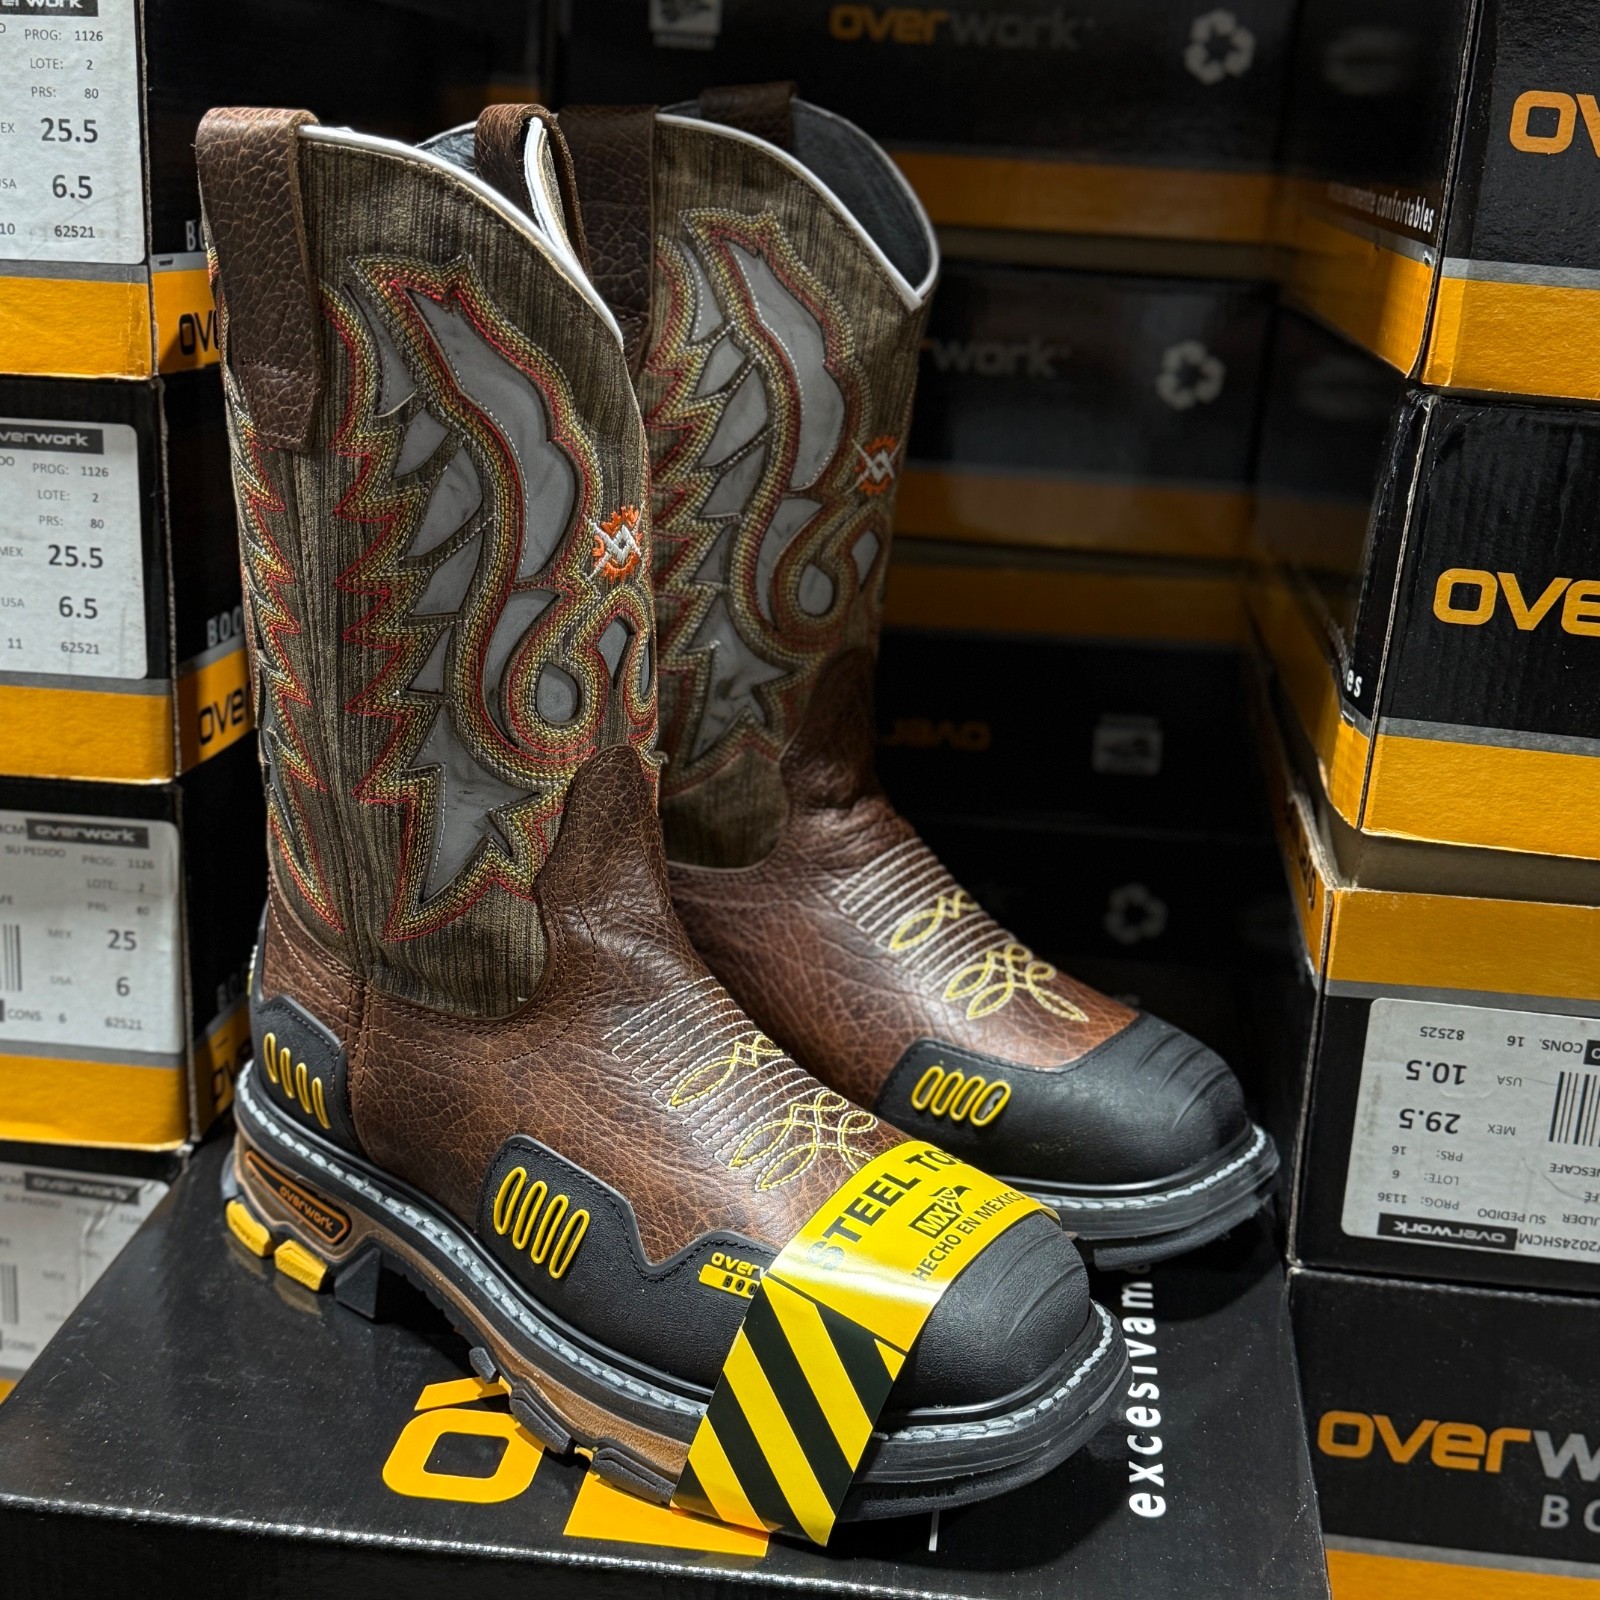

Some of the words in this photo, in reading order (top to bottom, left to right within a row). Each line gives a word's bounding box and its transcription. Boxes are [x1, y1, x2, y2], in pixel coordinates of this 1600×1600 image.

[24, 29, 62, 41] PROG:
[74, 30, 104, 42] 1126
[30, 58, 63, 70] LOTE:
[86, 60, 93, 71] 2
[31, 87, 56, 98] PRS:
[84, 88, 99, 100] 80
[40, 117, 99, 144] 25.5
[0, 178, 17, 190] SA
[52, 174, 93, 200] 6.5
[1376, 190, 1435, 233] confortables
[54, 224, 96, 239] 62521
[32, 462, 69, 476] PROG:
[80, 466, 110, 478] 1126
[37, 489, 70, 501] LOTE:
[91, 492, 100, 504] 2
[38, 514, 63, 527] PRS:
[90, 518, 105, 530] 80
[48, 544, 104, 569] 25.5
[1, 596, 25, 608] USA
[58, 595, 98, 620] 6.5
[7, 637, 24, 650] 11
[60, 641, 101, 655] 62521
[34, 824, 136, 842] overwork
[107, 929, 137, 951] 25
[116, 976, 130, 997] 6
[104, 1016, 143, 1031] 62521
[1419, 1026, 1466, 1041] 82525
[1506, 1035, 1526, 1048] 16
[1539, 1038, 1584, 1054] CONS.
[1405, 1059, 1468, 1086] 10.5
[1496, 1075, 1523, 1088] USA
[1398, 1108, 1462, 1135] 29.5
[1486, 1123, 1516, 1137] MEX
[1391, 1145, 1407, 1156] 16
[1436, 1149, 1463, 1163] PRS:
[1392, 1169, 1401, 1180] 6
[1423, 1172, 1460, 1186] LOTE:
[1377, 1191, 1408, 1204] 1136
[1420, 1195, 1460, 1210] PROG:
[279, 1185, 334, 1232] overwork
[806, 1172, 923, 1271] STEEL
[903, 1149, 965, 1173] TO
[1477, 1207, 1526, 1223] PEDIDO
[1528, 1213, 1547, 1225] SU
[910, 1233, 963, 1282] HECHO
[954, 1215, 983, 1236] EN
[973, 1191, 1026, 1221] MÉXICO
[1394, 1221, 1506, 1244] overwork
